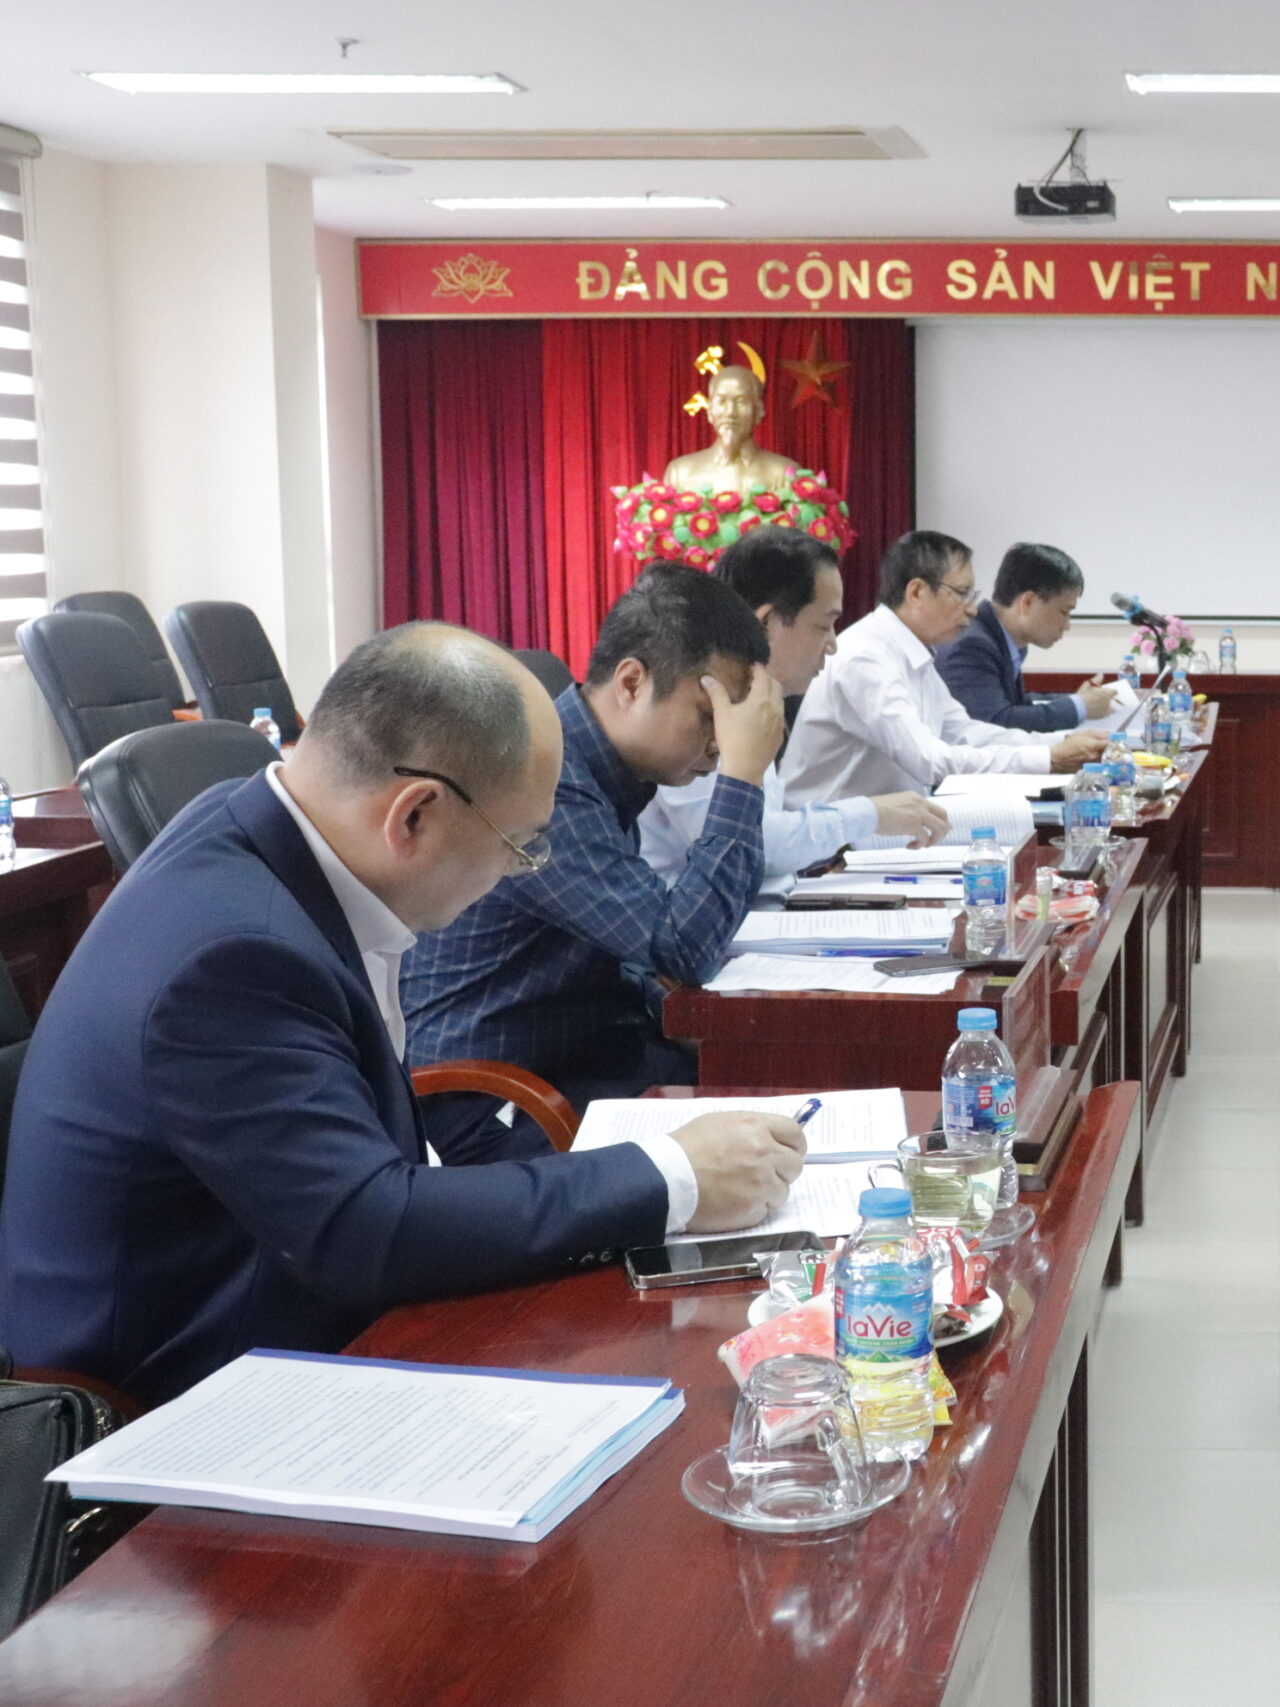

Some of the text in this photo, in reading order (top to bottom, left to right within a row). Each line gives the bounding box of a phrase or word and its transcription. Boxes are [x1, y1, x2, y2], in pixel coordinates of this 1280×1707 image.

[576, 248, 729, 300] ĐẢNG
[757, 251, 913, 309] CỘNG
[945, 249, 1055, 300] SẢN
[1089, 253, 1211, 311] VIỆT
[847, 1314, 912, 1338] laVie
